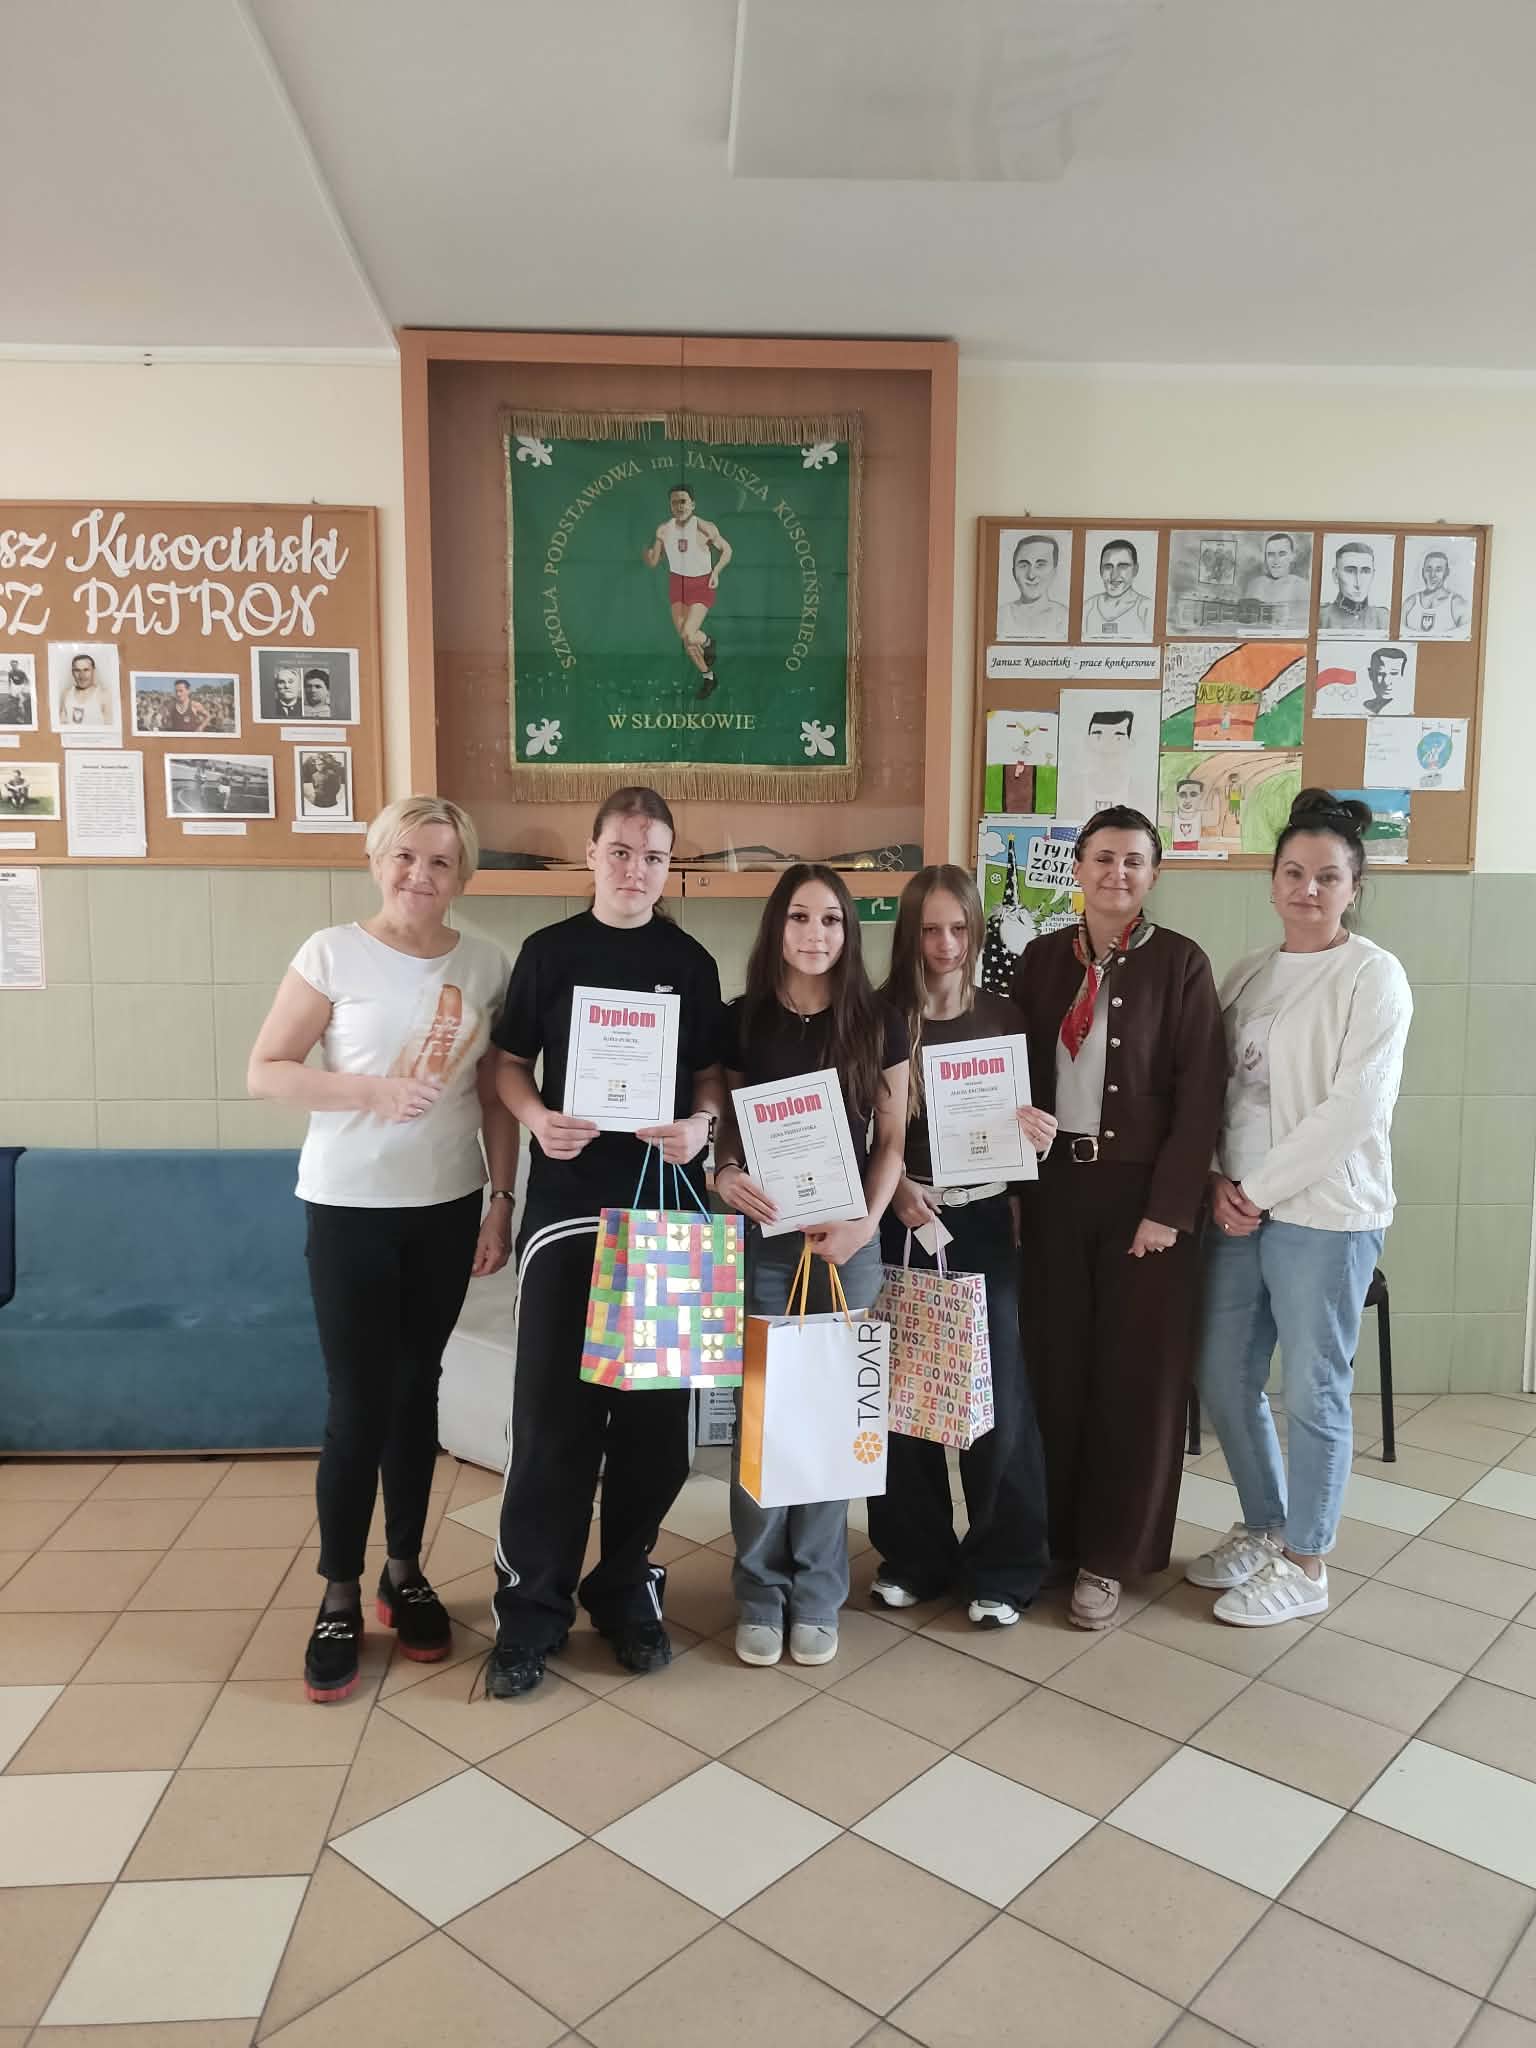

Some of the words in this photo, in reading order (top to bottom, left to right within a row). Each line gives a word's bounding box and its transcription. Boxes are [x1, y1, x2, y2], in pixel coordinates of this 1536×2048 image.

[544, 459, 642, 576] PODSTAWOWA
[73, 577, 328, 642] PATRON
[991, 657, 1021, 668] Janusz
[1024, 656, 1072, 669] Kusociński
[1079, 660, 1103, 670] prace
[1105, 657, 1156, 669] konkursowe
[608, 714, 627, 729] W
[631, 713, 755, 730] SŁODKOWIE
[1044, 844, 1061, 858] TY
[589, 1005, 656, 1028] Dyplom
[940, 1056, 1005, 1081] Dyplom
[754, 1093, 822, 1124] Dyplom
[857, 1324, 881, 1428] TADAR
